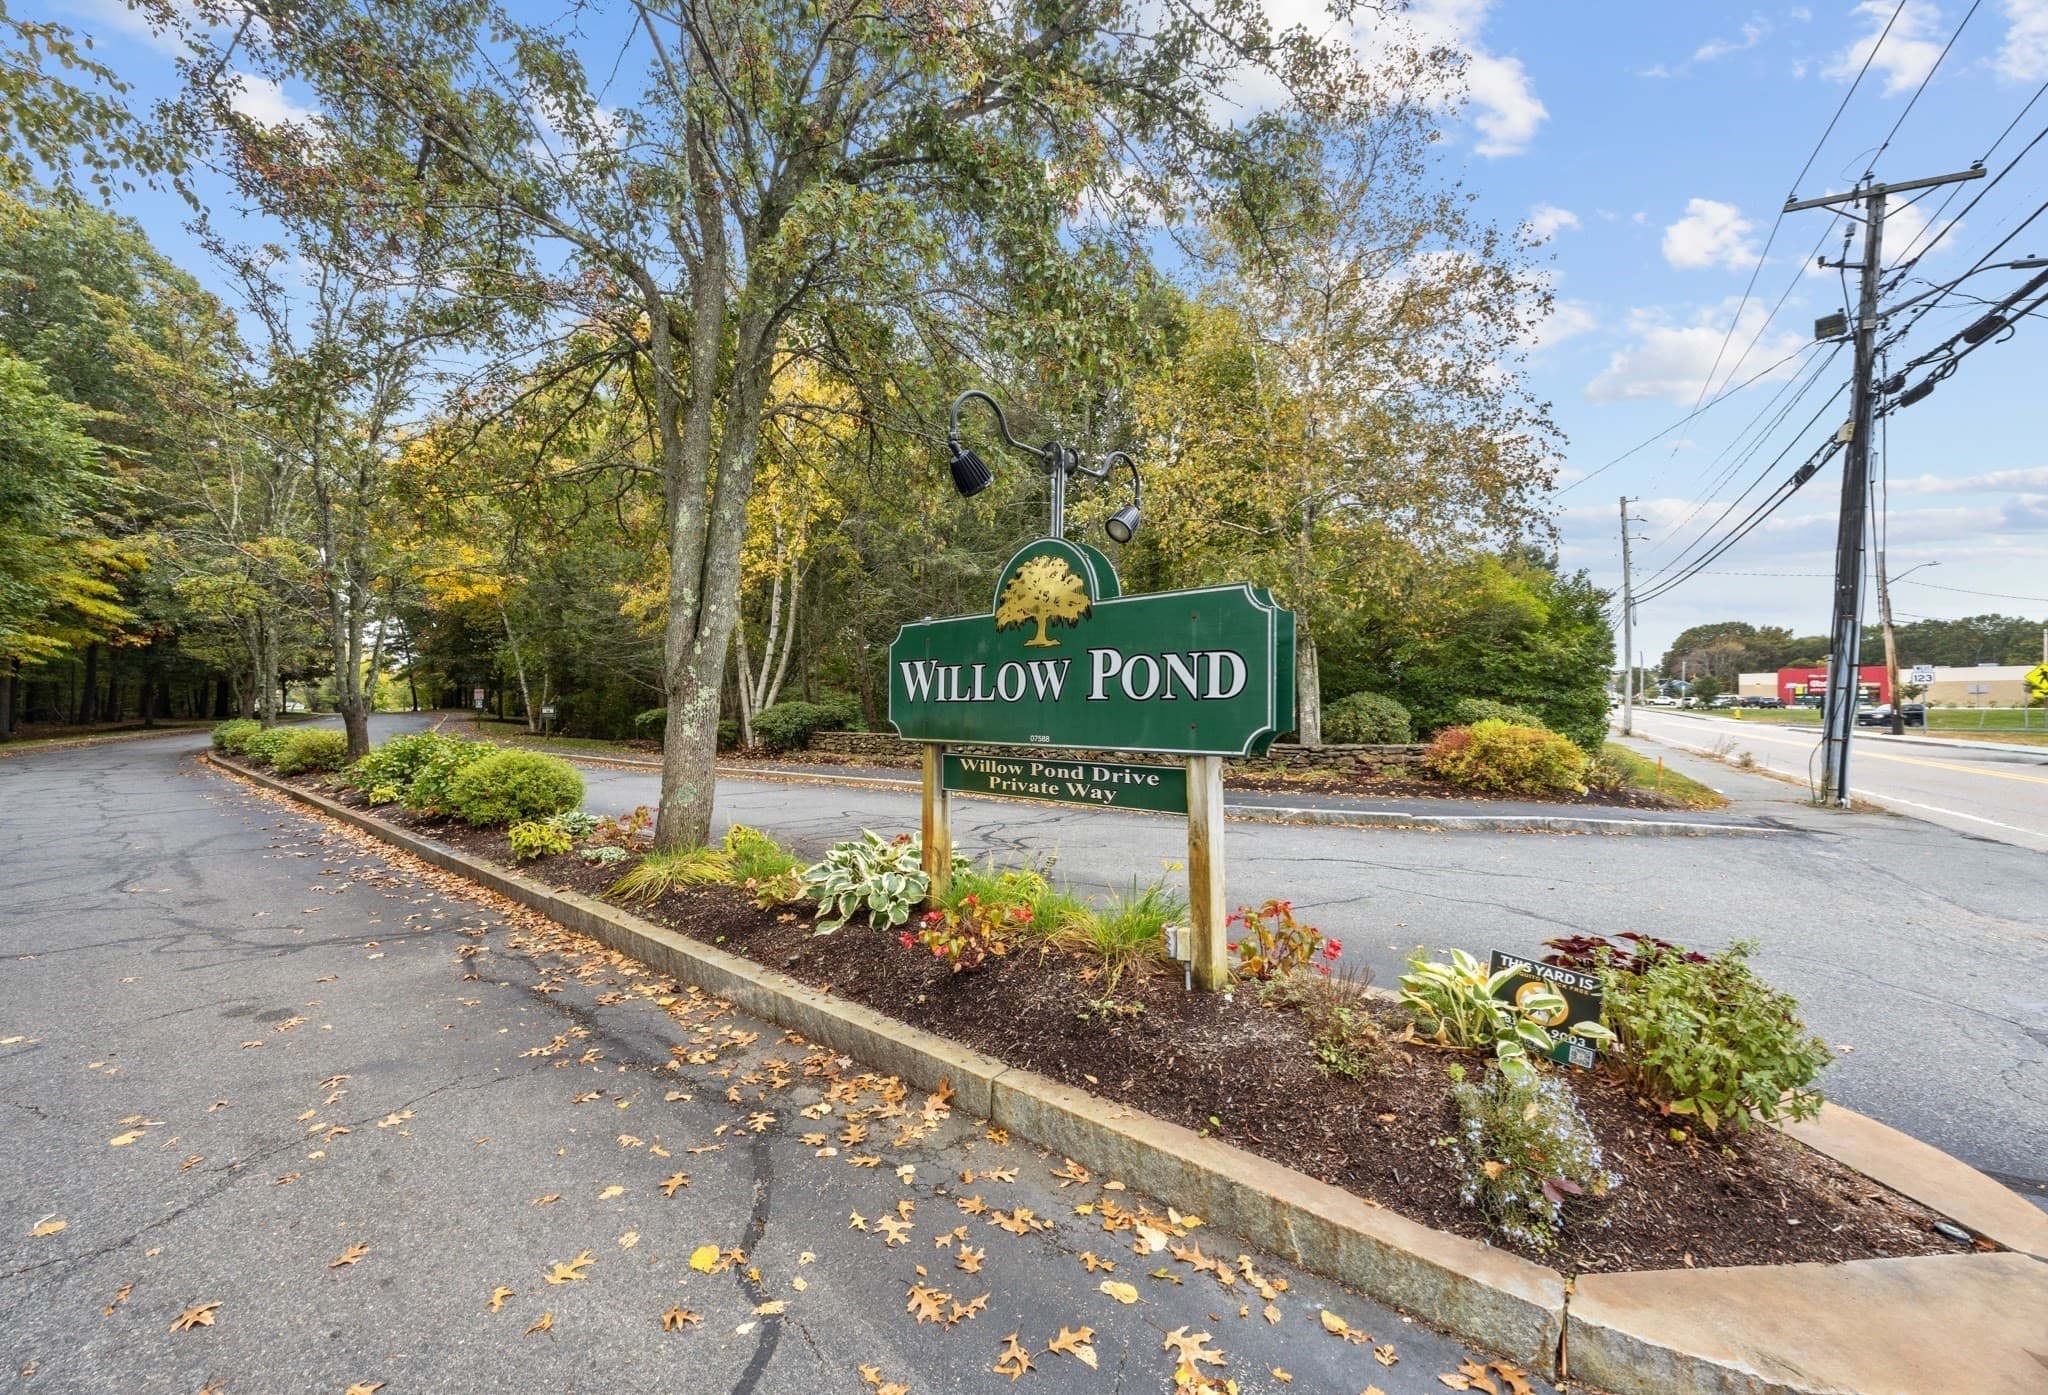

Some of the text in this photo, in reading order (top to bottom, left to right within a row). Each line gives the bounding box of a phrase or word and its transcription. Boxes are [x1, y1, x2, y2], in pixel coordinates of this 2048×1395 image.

[899, 649, 1248, 703] WILLOW POND
[1914, 674, 1932, 682] 123
[960, 758, 1160, 786] Willow Pond Drive
[988, 776, 1118, 804] Private Way
[1500, 955, 1594, 990] THS YARD IS
[1569, 986, 1589, 995] FREE
